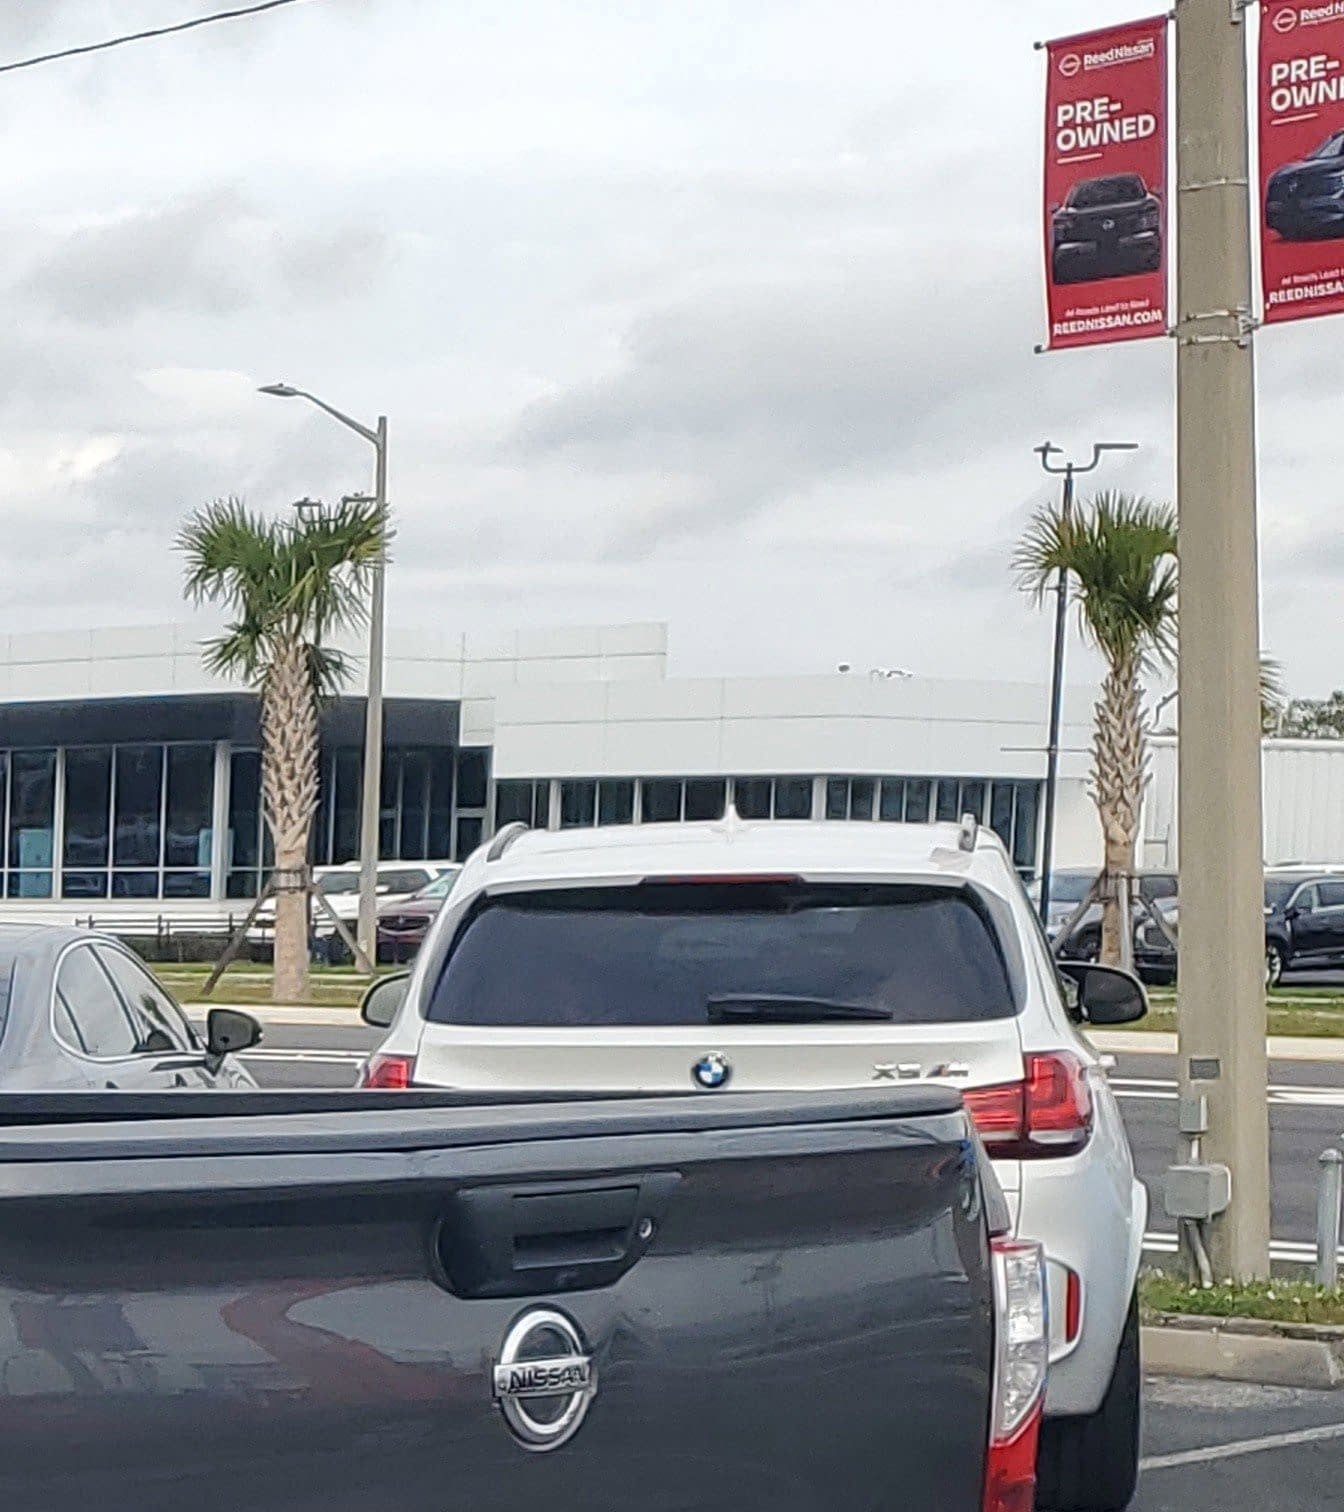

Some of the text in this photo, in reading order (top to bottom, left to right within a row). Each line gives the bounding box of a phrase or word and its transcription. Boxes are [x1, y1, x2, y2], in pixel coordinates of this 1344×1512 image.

[1271, 54, 1340, 87] PRE-
[1057, 96, 1122, 128] PRE-
[1056, 113, 1156, 151] OWNED
[1053, 309, 1163, 336] REEDNISSAN.COM
[872, 1063, 921, 1080] X5
[508, 1366, 586, 1391] NISSAN
